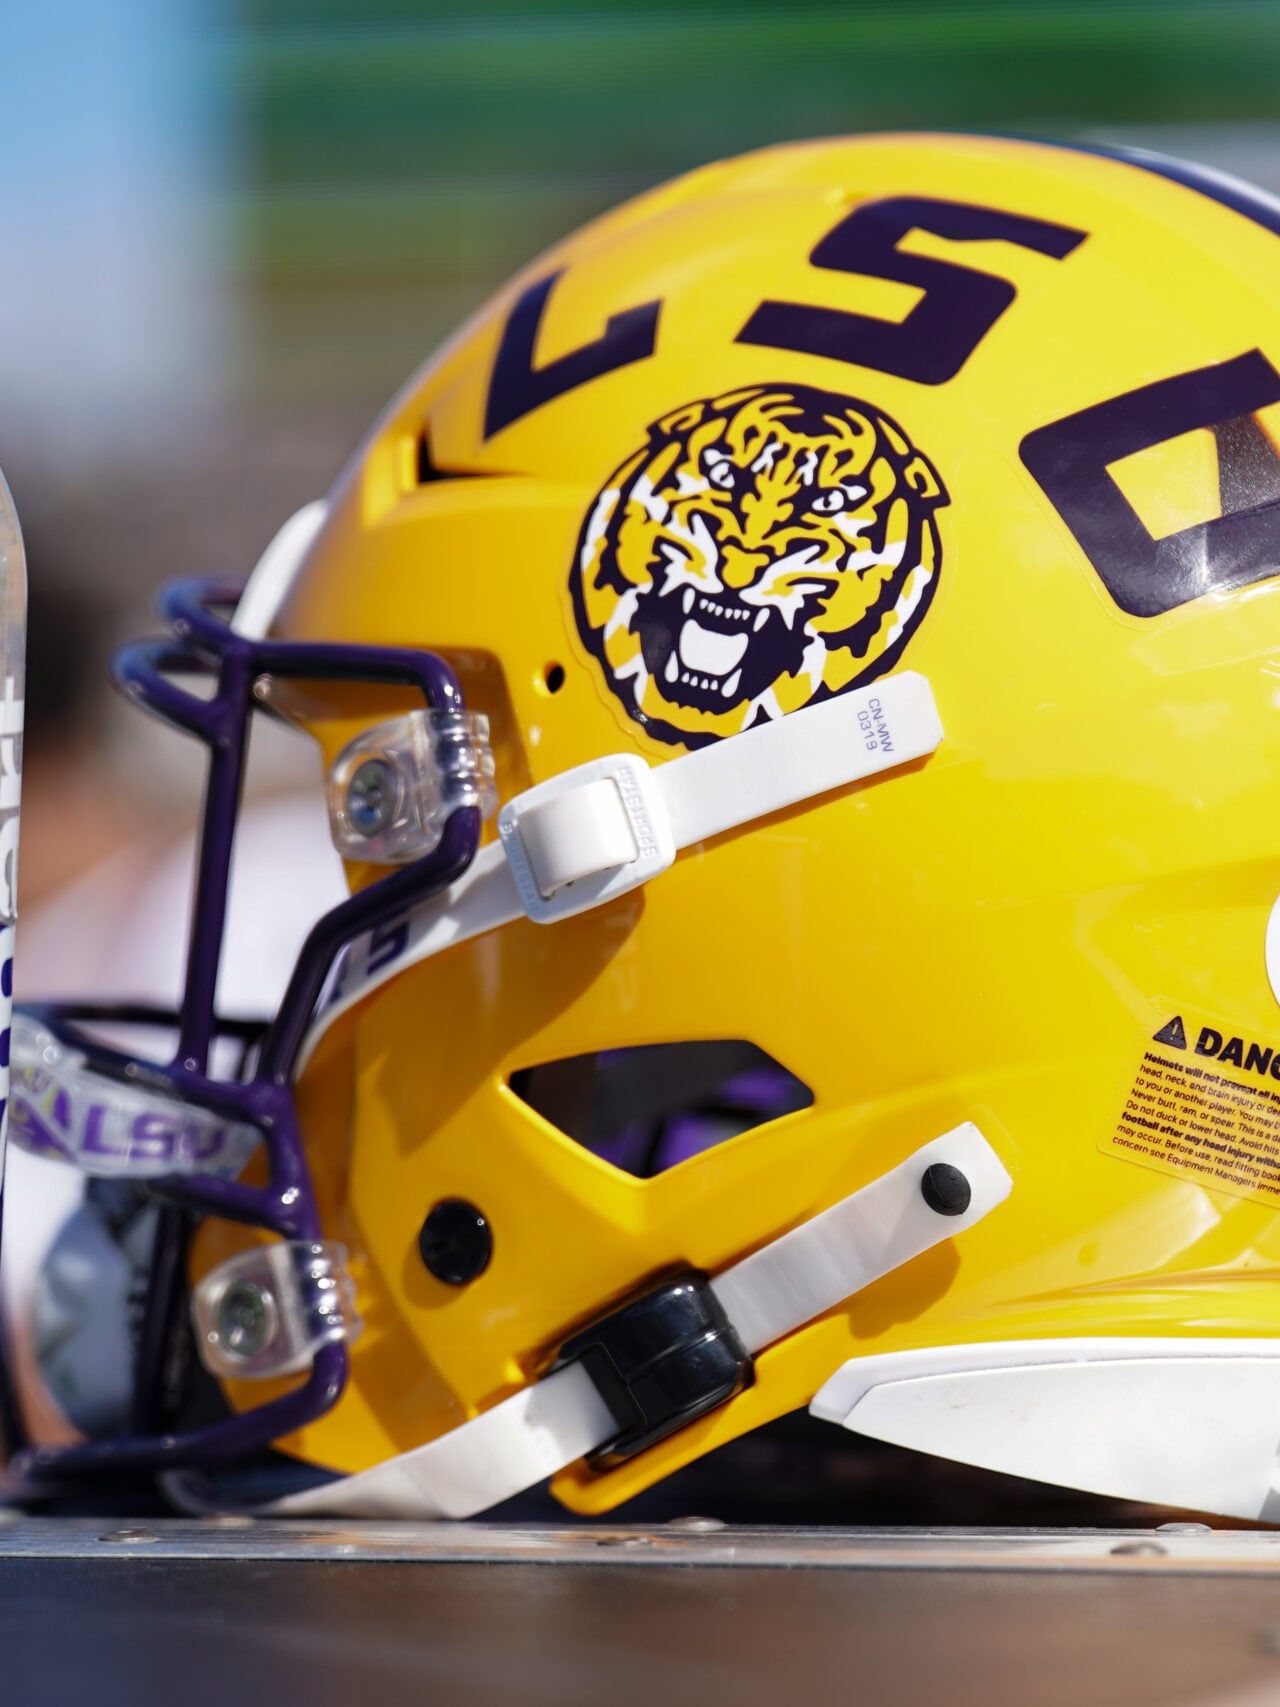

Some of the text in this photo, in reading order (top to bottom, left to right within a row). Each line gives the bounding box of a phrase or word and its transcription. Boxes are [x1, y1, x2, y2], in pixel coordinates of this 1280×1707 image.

[857, 710, 878, 751] 0319
[869, 698, 895, 753] CN-MW
[1143, 1051, 1184, 1072] Helmets
[1185, 1066, 1204, 1078] will
[1203, 1072, 1221, 1084] not
[1219, 1078, 1258, 1096] prevent
[1189, 1082, 1208, 1093] and
[1207, 1086, 1230, 1101] brain
[1230, 1095, 1256, 1110] injury
[1256, 1103, 1266, 1111] or
[1125, 1099, 1139, 1111] Do
[1139, 1105, 1156, 1117] not
[1155, 1111, 1178, 1124] duck
[1178, 1118, 1189, 1127] or
[1189, 1120, 1214, 1135] lower
[1213, 1128, 1237, 1143] head.
[1238, 1136, 1263, 1151] Avoid
[1263, 1144, 1280, 1156] hits
[1130, 1088, 1157, 1103] Never
[1199, 1112, 1210, 1120] or
[1238, 1122, 1256, 1135] This
[1255, 1129, 1265, 1138] is
[1135, 1076, 1145, 1086] to
[1145, 1081, 1163, 1092] you
[1163, 1086, 1173, 1095] or
[1173, 1090, 1208, 1106] another
[1239, 1109, 1255, 1122] You
[1254, 1116, 1274, 1129] may
[80, 1103, 229, 1160] LSU
[1116, 1124, 1137, 1138] may
[1164, 1139, 1194, 1156] Before
[1214, 1156, 1235, 1168] read
[1234, 1161, 1261, 1178] fitting
[1121, 1111, 1160, 1131] football
[1159, 1125, 1185, 1139] after
[1184, 1133, 1203, 1146] any
[1202, 1137, 1228, 1153] head
[1226, 1145, 1256, 1163] injury
[1112, 1136, 1149, 1154] concern
[1166, 1153, 1214, 1175] Equipment
[1214, 1168, 1256, 1188] Managers
